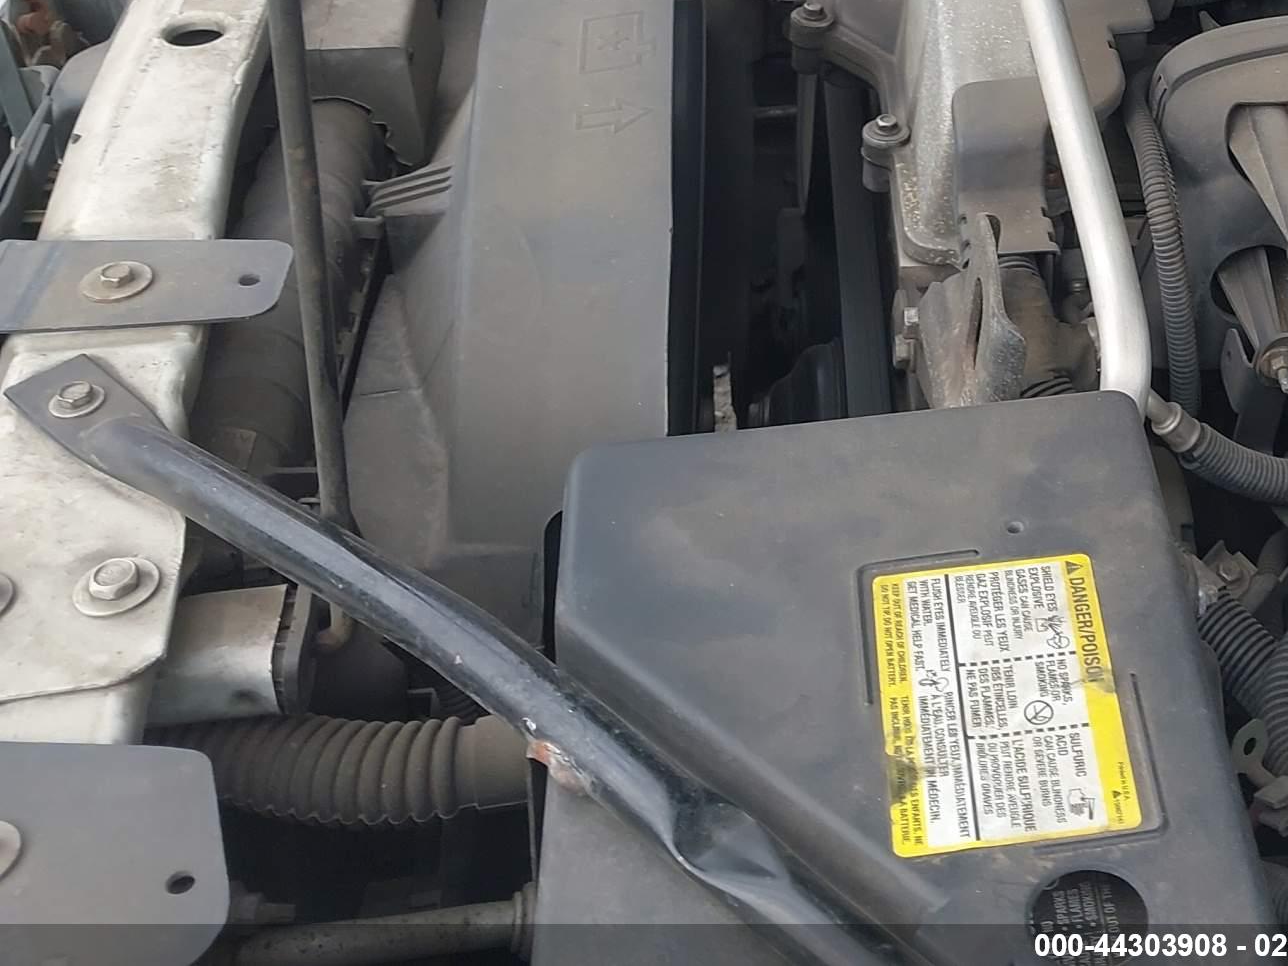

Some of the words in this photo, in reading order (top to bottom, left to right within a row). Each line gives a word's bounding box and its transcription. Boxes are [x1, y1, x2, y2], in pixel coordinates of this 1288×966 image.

[906, 580, 917, 595] GET
[918, 579, 929, 597] WITH
[929, 578, 942, 601] FLUSH
[975, 573, 987, 588] GAZ
[1004, 569, 1018, 604] BLINDNESS
[1014, 568, 1028, 594] GASES
[1027, 566, 1045, 610] EXPLOSIVE
[1039, 565, 1054, 592] SHIELD
[907, 596, 921, 628] MEDICAL
[932, 601, 945, 620] EYES
[964, 574, 976, 598] RENDRE
[971, 629, 982, 640] OU
[977, 589, 993, 628] EXPLOSIF
[1009, 605, 1020, 615] OR
[1019, 594, 1031, 609] CAN
[1044, 592, 1058, 612] EYES
[994, 613, 1006, 628] LES
[1011, 615, 1024, 640] INJURY
[1021, 609, 1034, 632] CAUSE
[911, 629, 923, 649] HELP
[934, 621, 951, 672] IMMEDIATELY
[983, 629, 995, 646] PEUT
[996, 630, 1010, 653] YEUX
[965, 668, 976, 680] NE
[977, 667, 989, 683] DES
[989, 665, 1002, 682] DES
[1044, 659, 1059, 689] FLAMES
[1055, 658, 1067, 670] NO
[1002, 664, 1015, 689] TENIR
[1033, 660, 1049, 697] SMOKING
[966, 681, 978, 697] PAS
[1006, 689, 1018, 708] LOIN
[1049, 689, 1061, 701] OR
[942, 691, 956, 721] RINCER
[969, 699, 982, 728] FUMER
[934, 728, 950, 777] CONSULTER
[999, 740, 1011, 758] PEUT
[1031, 736, 1042, 748] OR
[1042, 735, 1055, 752] CAN
[1054, 733, 1069, 756] ACID
[1068, 731, 1087, 777] SULFURIC
[1002, 759, 1015, 791] RENDRE
[1033, 748, 1047, 778] SEVERE
[1045, 752, 1059, 777] CAUSE
[1016, 775, 1037, 831] SULFURIQUE
[1037, 779, 1051, 807] BURNS
[1049, 779, 1067, 824] BLINDNESS
[1052, 890, 1070, 925] SPARKS
[1066, 888, 1084, 923] FLAMES
